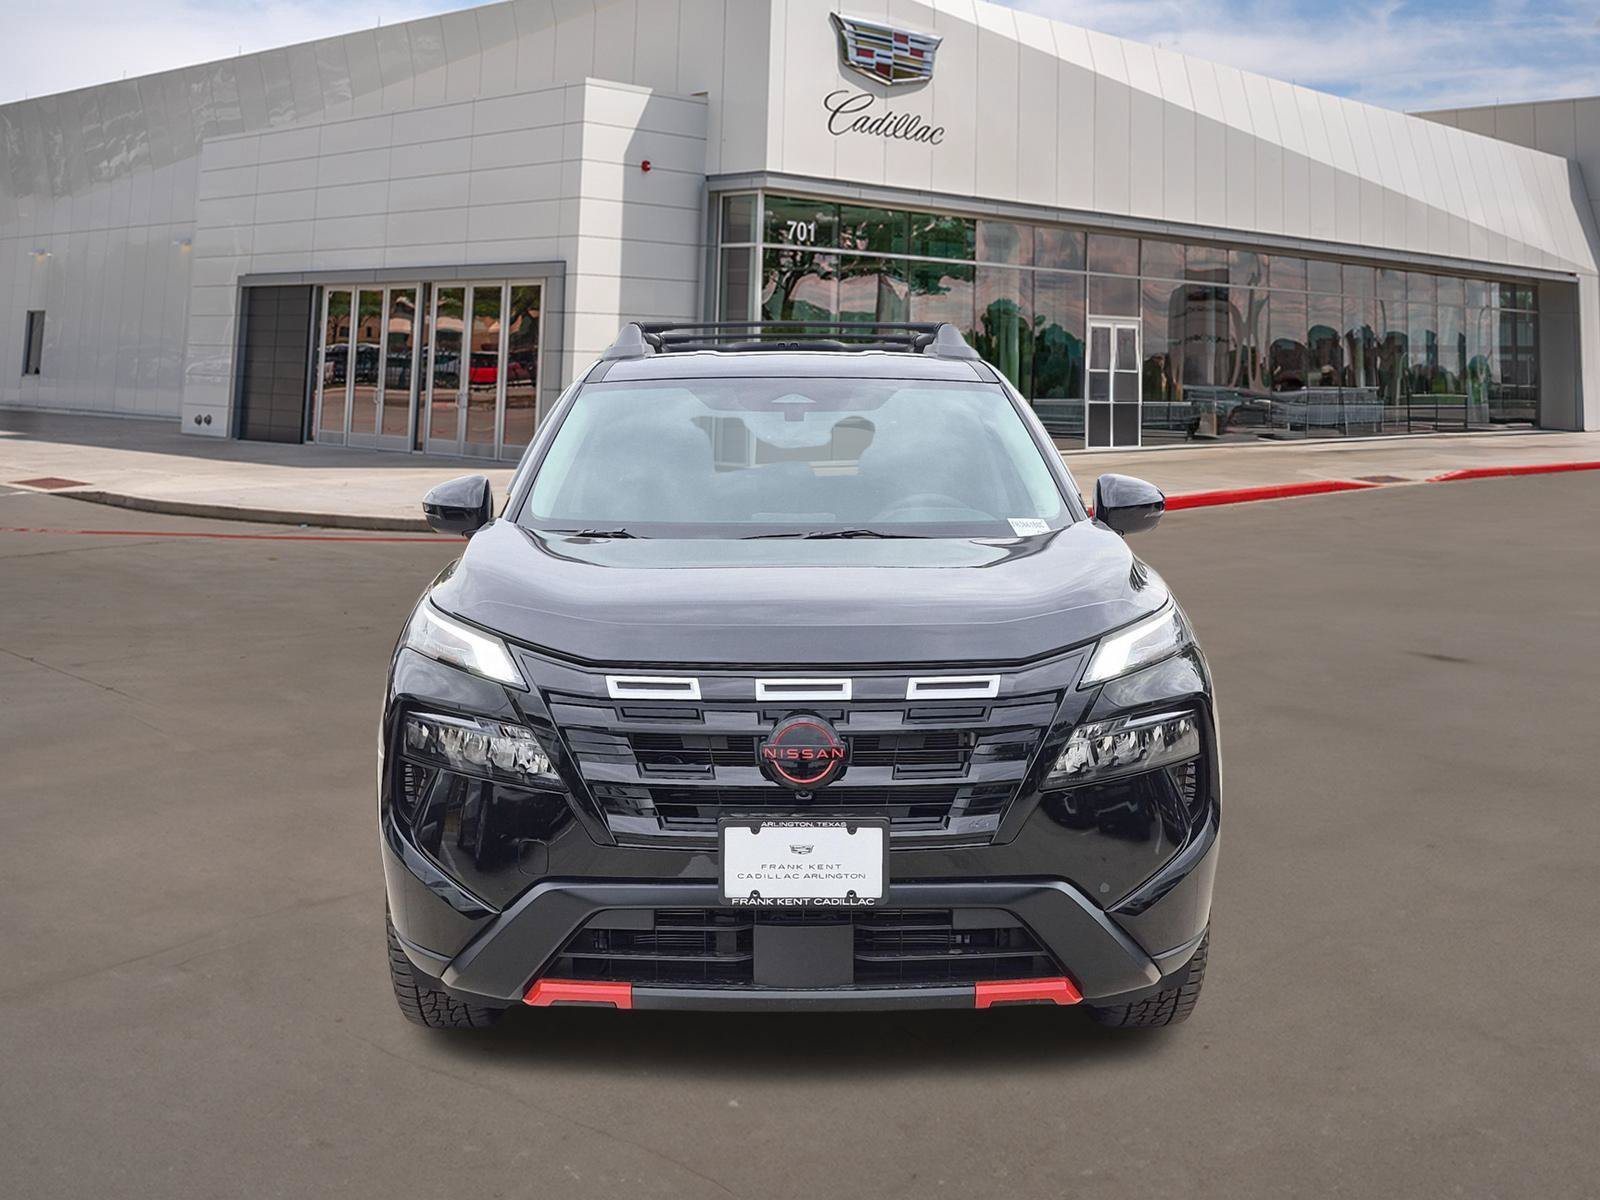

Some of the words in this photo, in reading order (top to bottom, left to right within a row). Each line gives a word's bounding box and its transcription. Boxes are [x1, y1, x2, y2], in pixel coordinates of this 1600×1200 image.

[823, 90, 945, 146] Cadillac
[786, 220, 816, 242] 701
[763, 748, 845, 759] NISSAN
[731, 898, 774, 906] FRANK
[777, 898, 811, 906] KENT
[813, 898, 875, 906] CADILLAC
